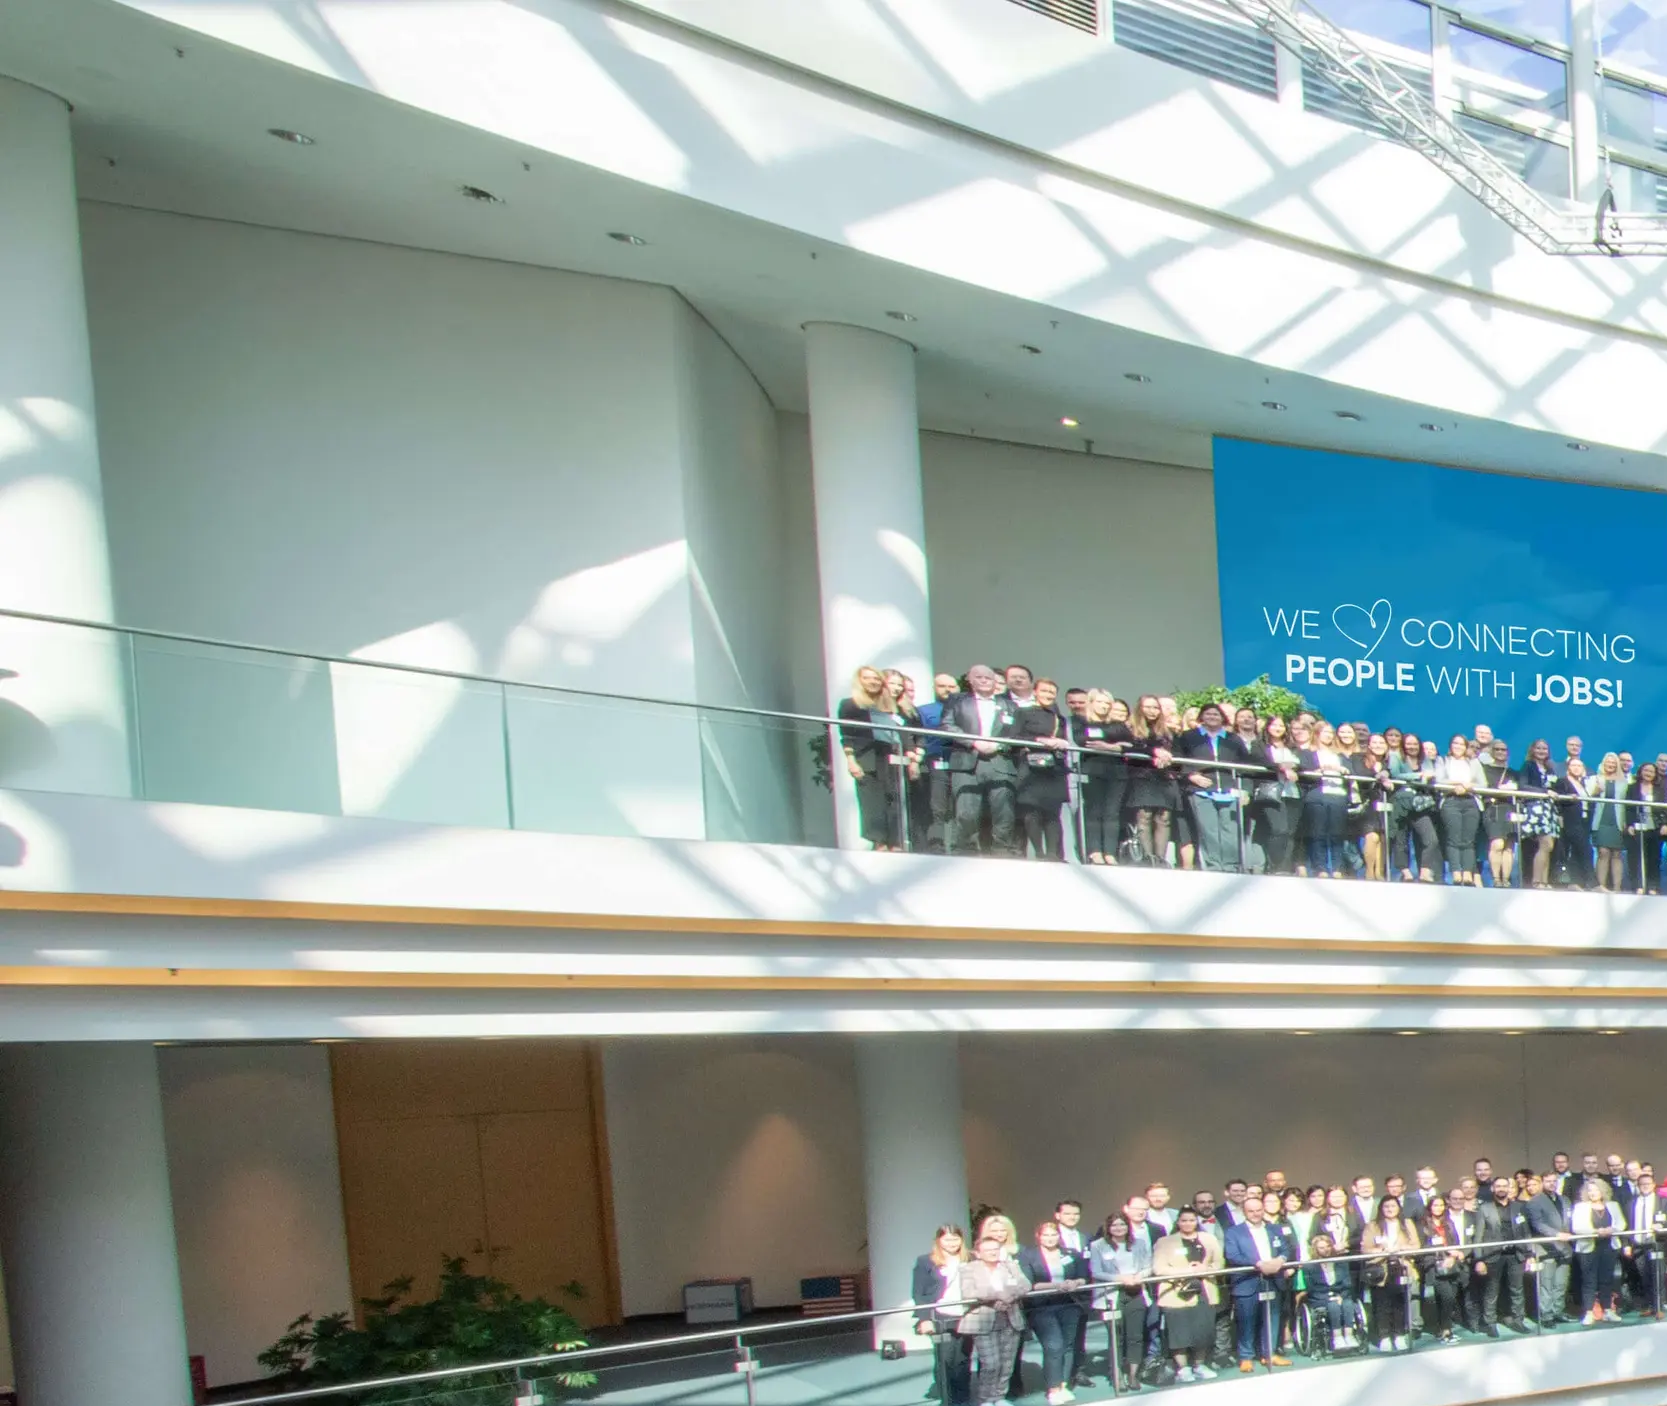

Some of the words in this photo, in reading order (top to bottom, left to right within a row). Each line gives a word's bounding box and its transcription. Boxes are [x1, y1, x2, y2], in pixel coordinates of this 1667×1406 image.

[1263, 606, 1321, 640] WE
[1400, 617, 1636, 664] CONNECTING
[1285, 654, 1416, 693] PEOPLE
[1426, 664, 1516, 700] WITH
[1527, 673, 1624, 709] JOBS!
